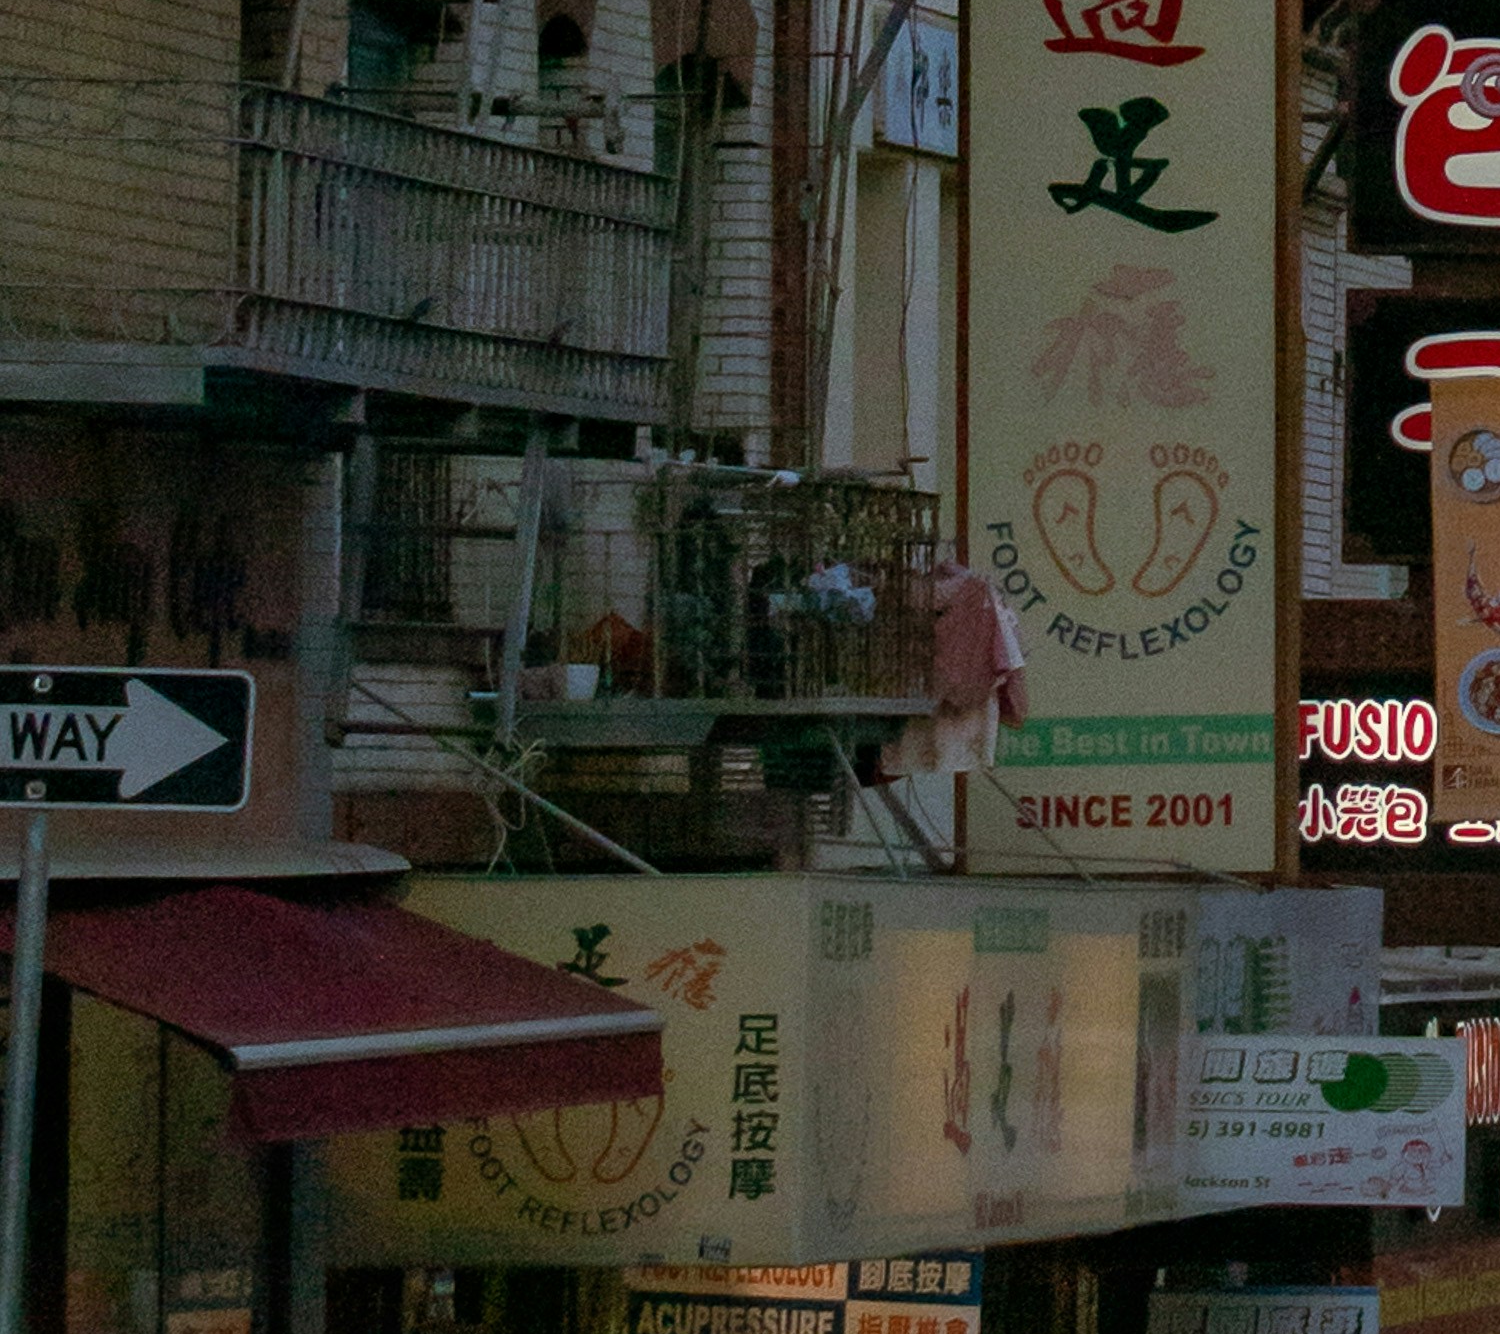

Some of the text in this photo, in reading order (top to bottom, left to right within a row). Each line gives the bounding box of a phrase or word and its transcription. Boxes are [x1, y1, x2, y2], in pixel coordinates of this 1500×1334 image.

[985, 519, 1262, 660] FOOT REFLEXOLOGY
[10, 713, 122, 761] WAY
[1000, 725, 1271, 758] he Best in Town
[1300, 699, 1438, 762] FUSIO
[1016, 793, 1233, 828] SINCE 2001
[728, 1013, 781, 1201] 足底按摩
[1254, 1092, 1311, 1107] TOUR
[1215, 1121, 1326, 1138] 391-8981
[517, 1118, 711, 1236] REFLEXOLOGY
